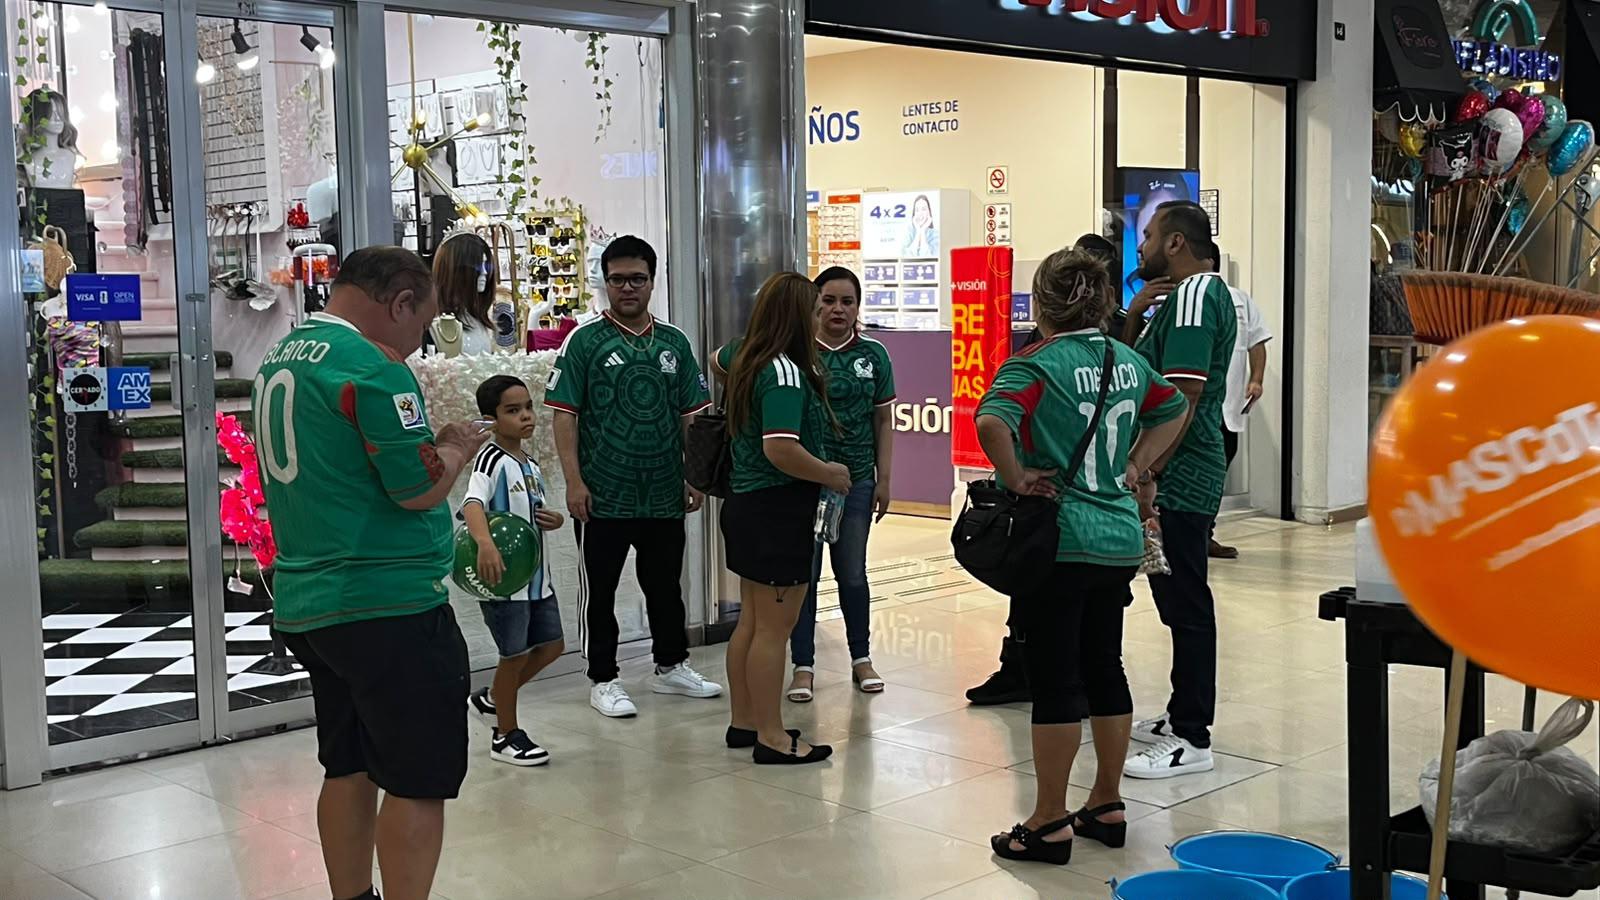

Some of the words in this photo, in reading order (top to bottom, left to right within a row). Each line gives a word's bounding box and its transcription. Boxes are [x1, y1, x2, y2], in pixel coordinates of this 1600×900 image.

[902, 102, 942, 117] LENTES
[944, 100, 959, 113] DE
[809, 105, 860, 145] ÑOS
[903, 119, 959, 136] CONTACTO
[870, 206, 882, 219] 4
[893, 204, 906, 218] 2
[75, 293, 95, 302] VISA
[113, 291, 135, 300] OPEN
[952, 303, 985, 335] RE
[264, 339, 331, 365] BLANCO
[952, 339, 985, 371] BA
[118, 373, 152, 390] AM
[952, 375, 986, 400] JAS
[122, 388, 152, 404] EX
[254, 368, 299, 486] 10
